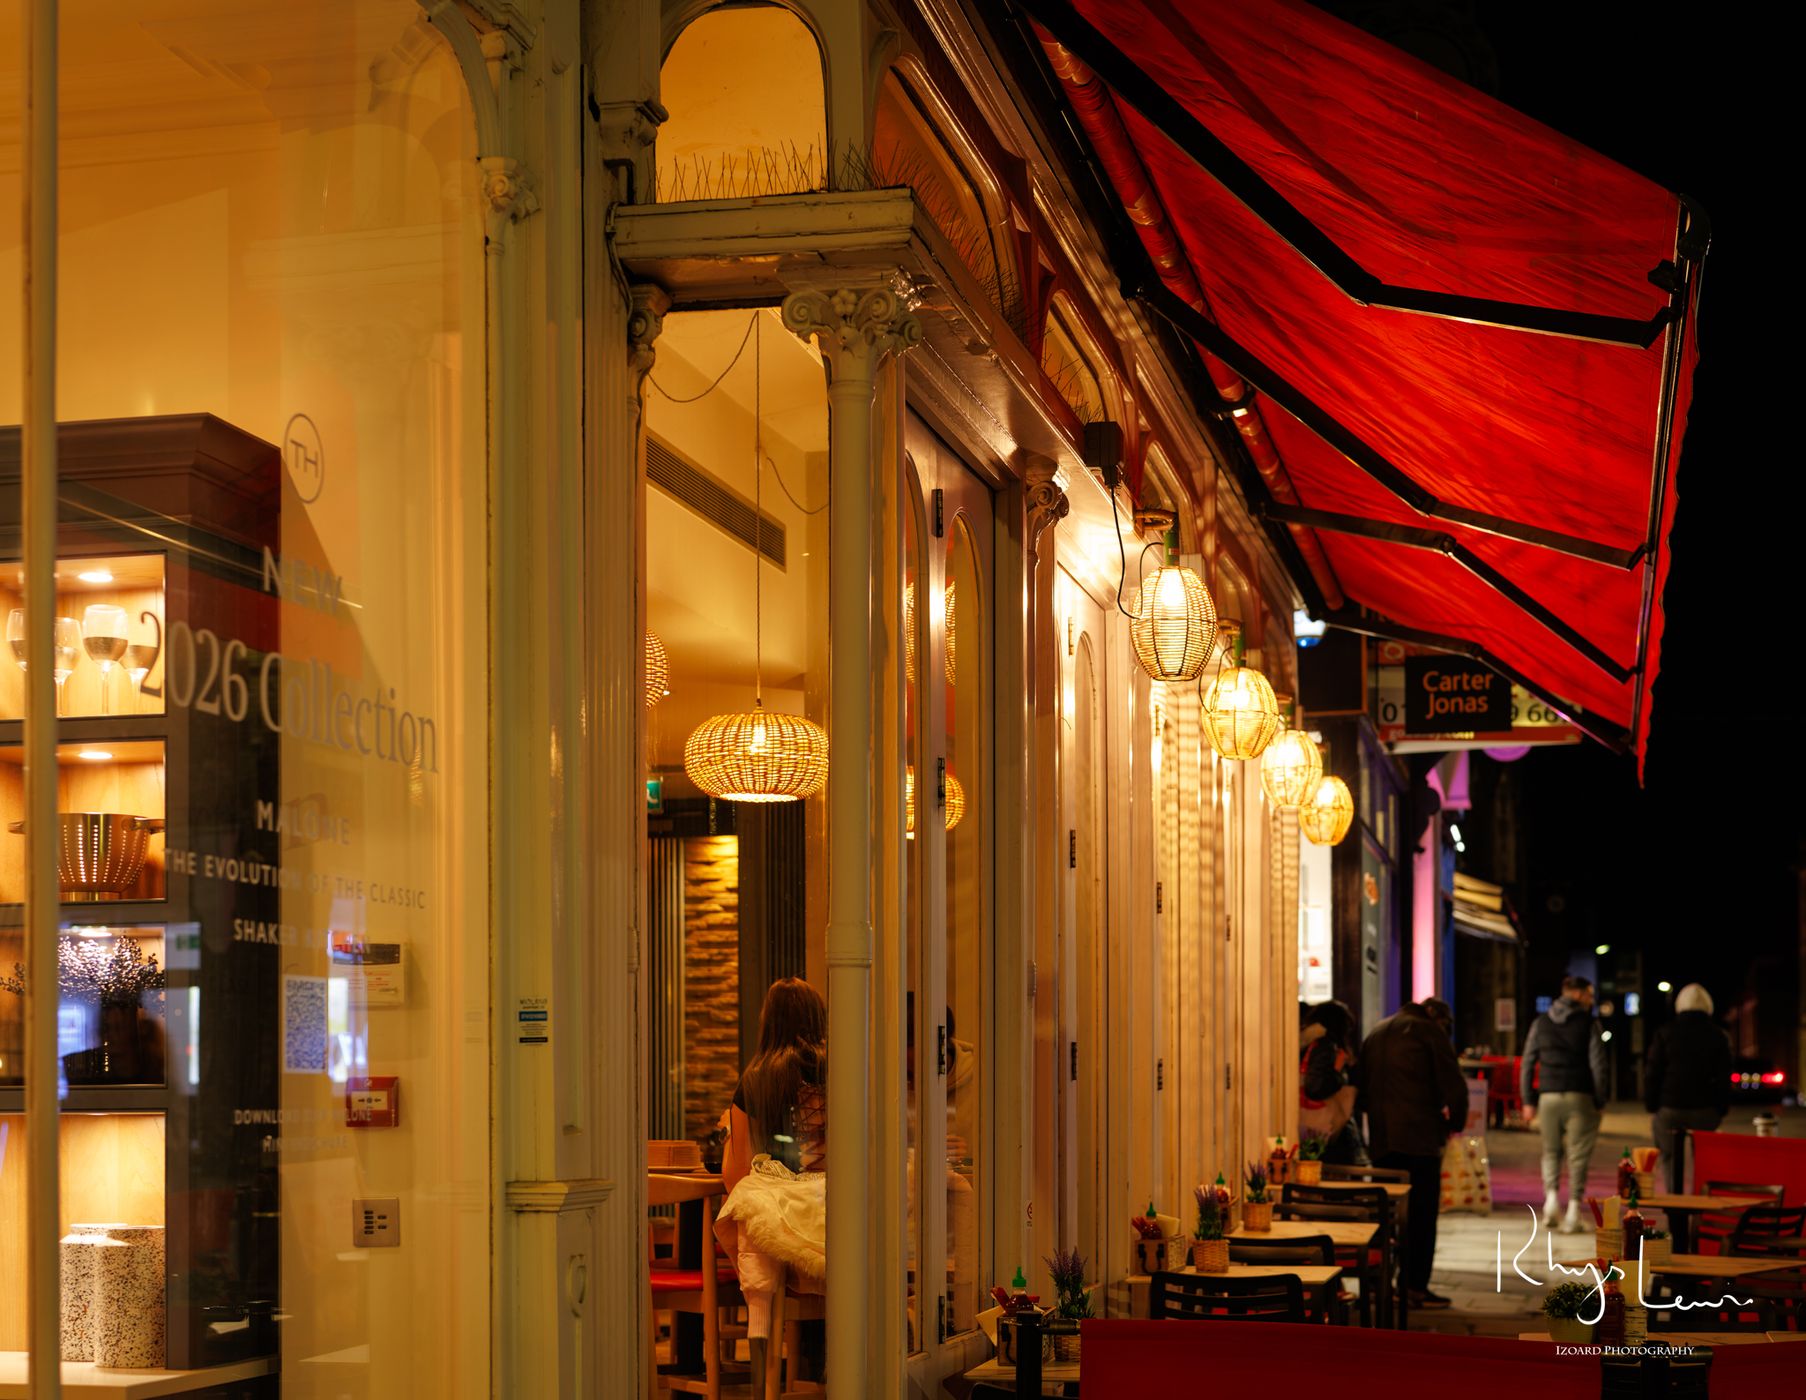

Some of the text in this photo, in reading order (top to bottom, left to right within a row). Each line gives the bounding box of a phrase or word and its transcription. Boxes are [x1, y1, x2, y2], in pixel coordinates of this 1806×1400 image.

[262, 545, 343, 617] NEW
[140, 610, 439, 774] 2026 Collection
[1423, 671, 1494, 692] Carter
[1426, 692, 1488, 719] Jonas
[256, 799, 350, 846] MALONE
[163, 848, 426, 910] THE EVOLUTION OF THE CLASSIC
[234, 1108, 300, 1125] DOWNLO
